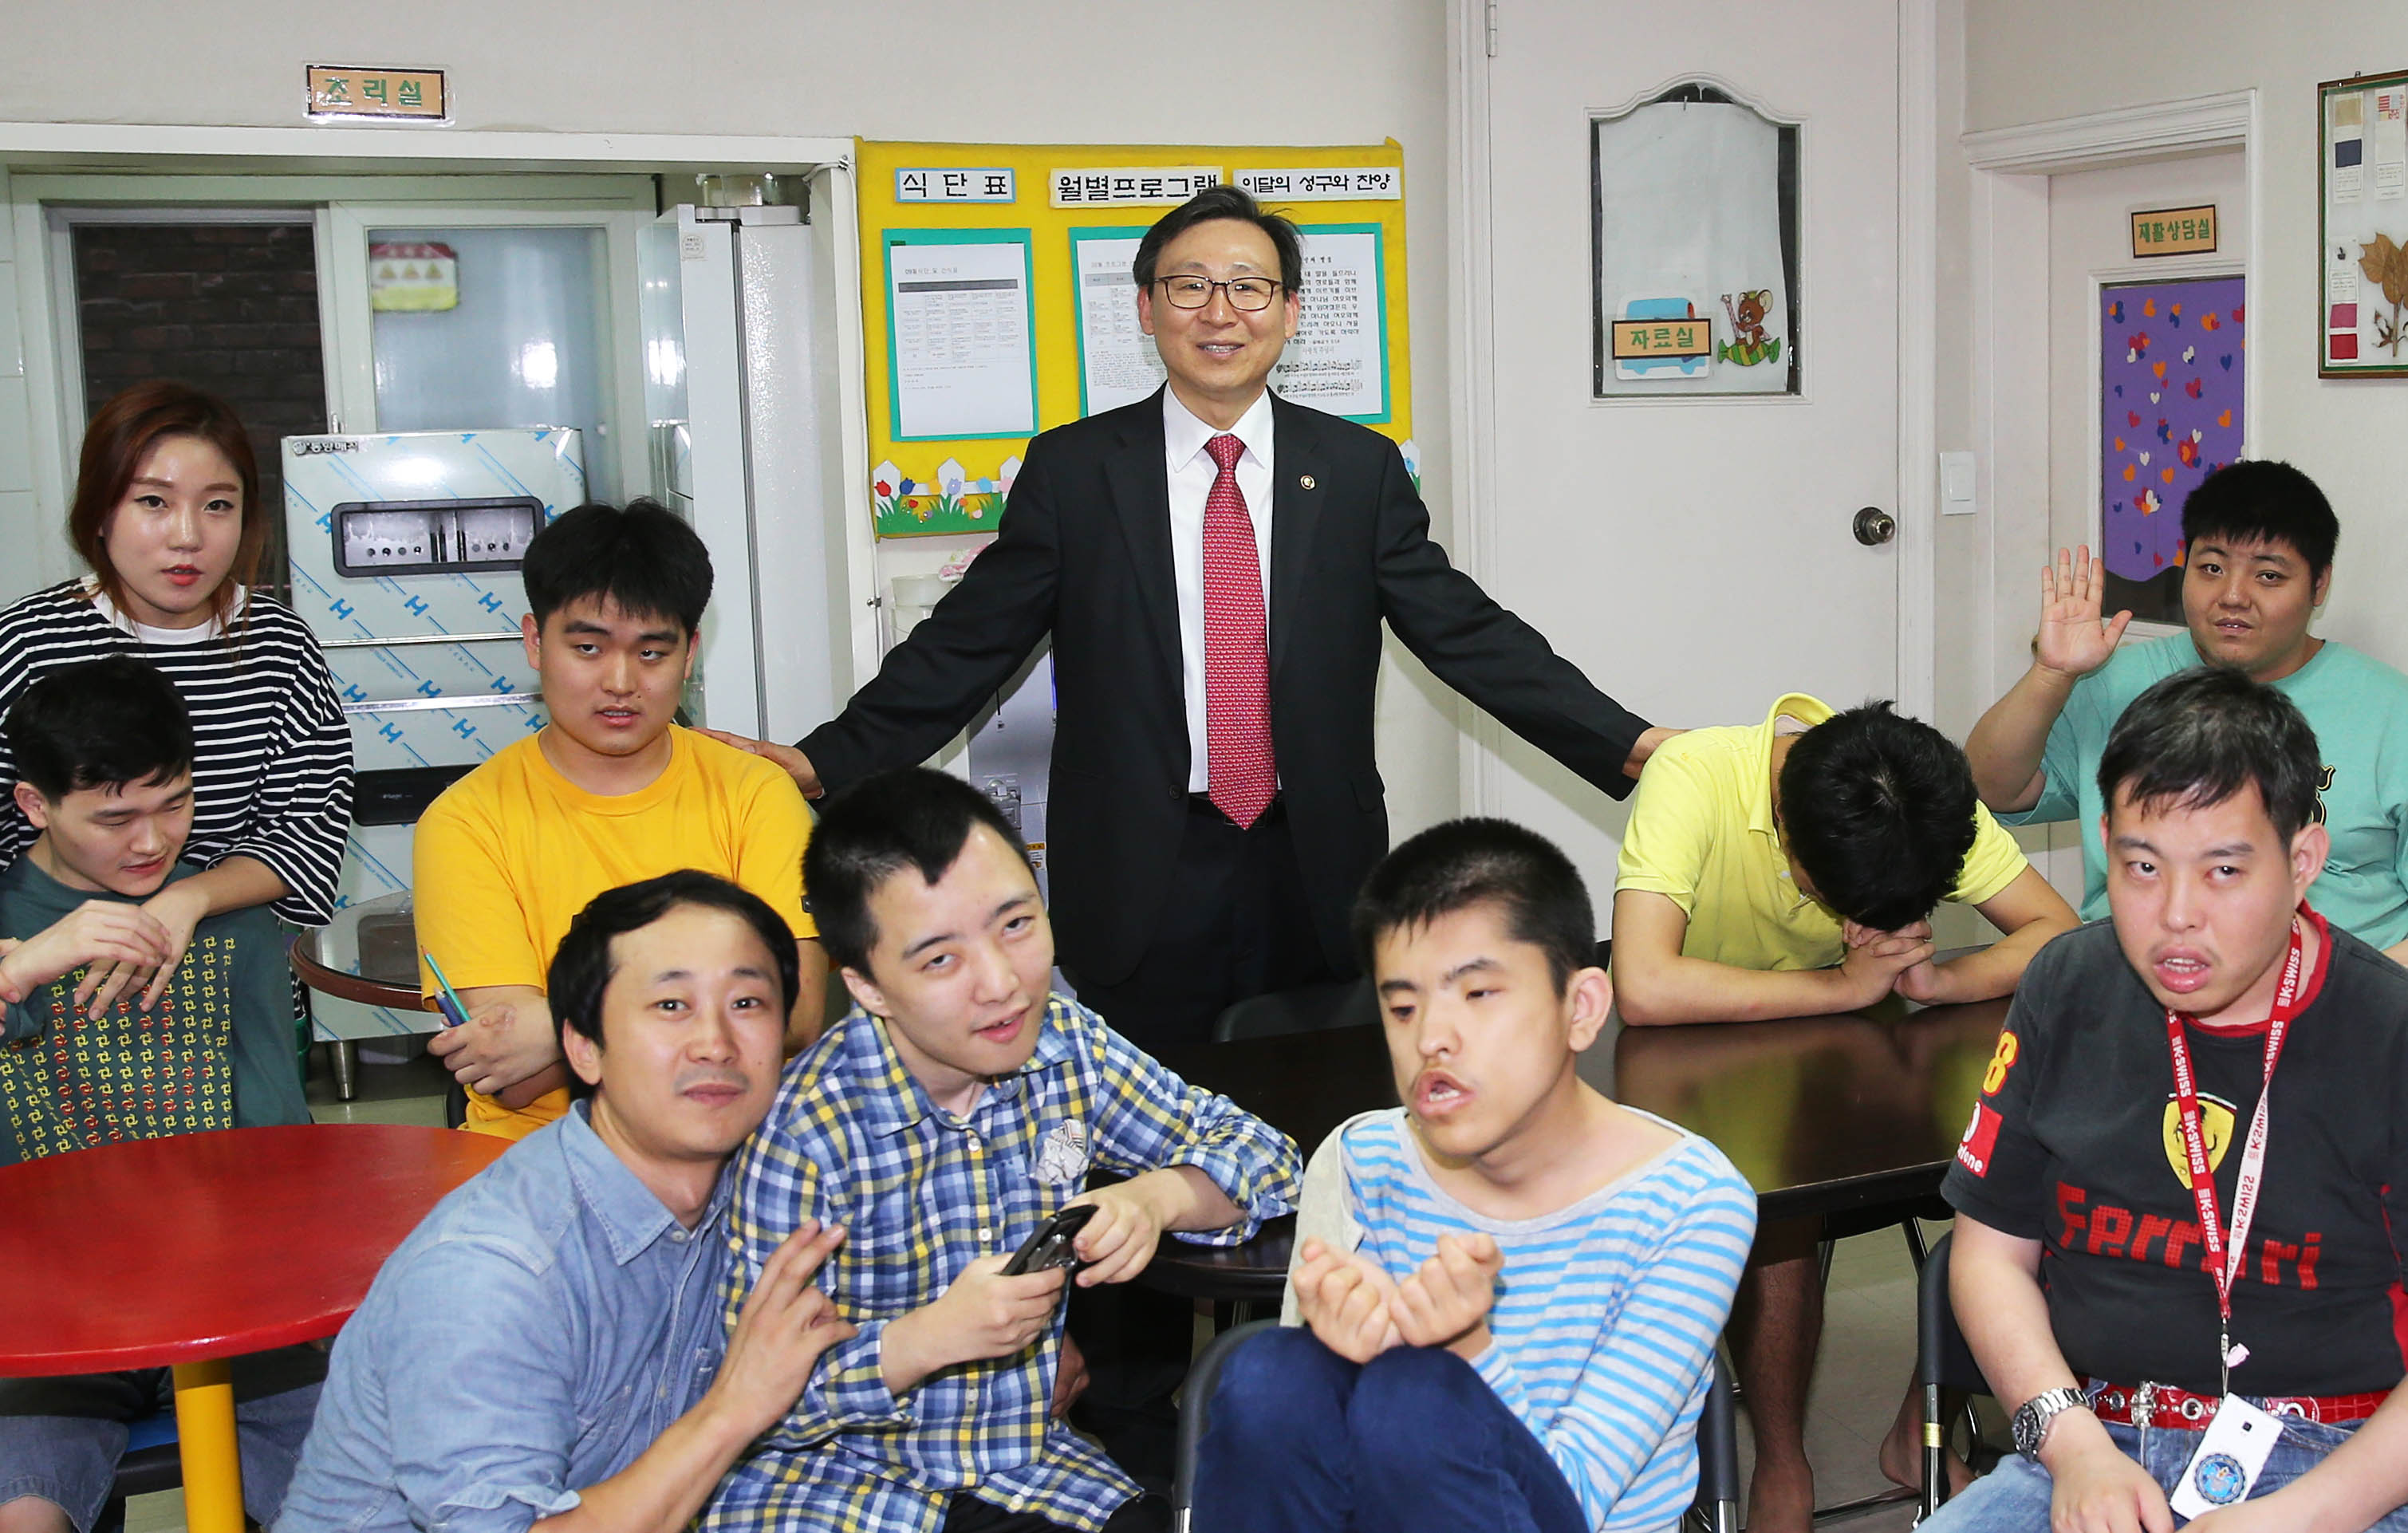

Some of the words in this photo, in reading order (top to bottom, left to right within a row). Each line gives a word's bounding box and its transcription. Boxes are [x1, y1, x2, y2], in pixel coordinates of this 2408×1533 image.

[321, 77, 422, 108] 조리실
[903, 173, 1007, 197] 식단표
[1243, 176, 1291, 193] 이달의
[1299, 175, 1350, 191] 성구와
[1357, 174, 1390, 191] 찬양
[2138, 219, 2209, 242] 재활상담실
[1630, 328, 1694, 349] 자료실
